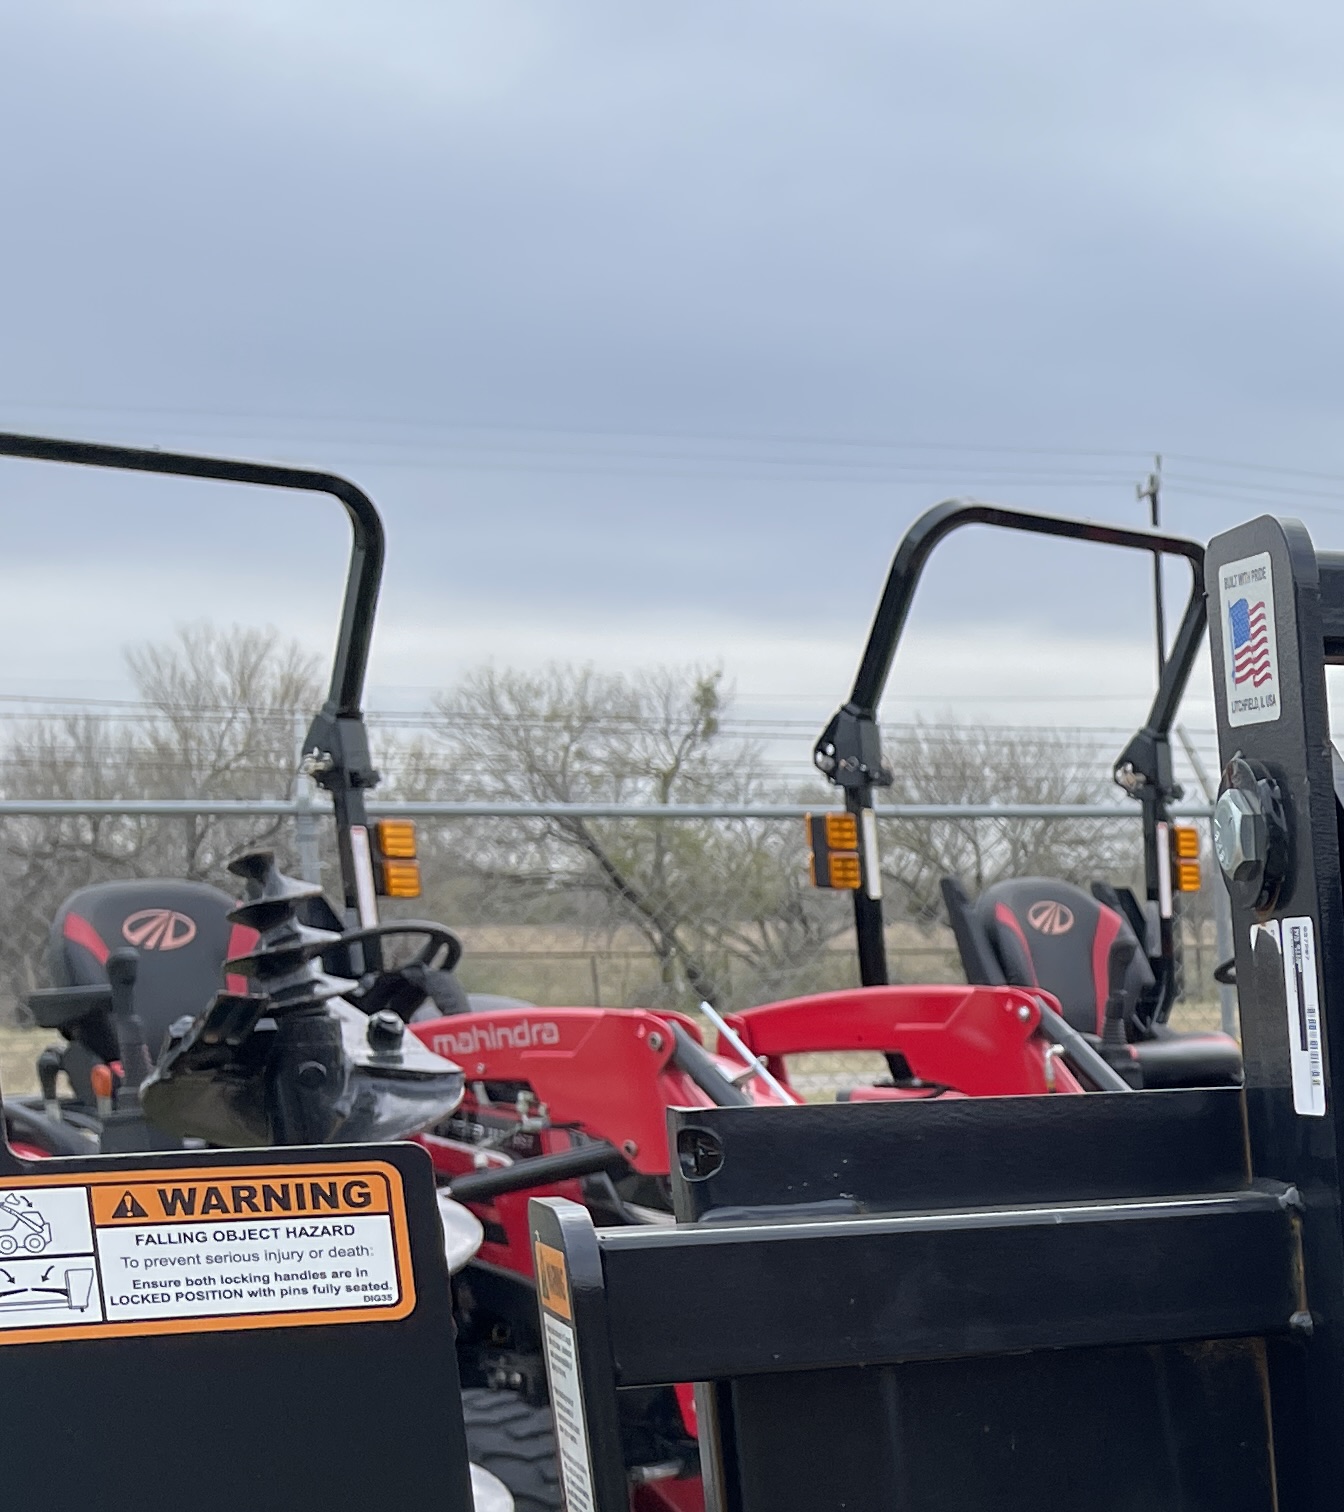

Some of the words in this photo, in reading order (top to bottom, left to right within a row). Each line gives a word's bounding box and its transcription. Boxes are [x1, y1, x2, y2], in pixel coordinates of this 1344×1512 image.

[432, 1019, 560, 1054] mahindra
[157, 1180, 372, 1216] WARNING
[135, 1231, 208, 1246] FALLING
[212, 1227, 281, 1243] OBJECT
[286, 1224, 355, 1239] HAZARD
[120, 1256, 139, 1269] To
[144, 1253, 202, 1270] prevent
[205, 1249, 260, 1265] serious
[264, 1249, 304, 1264] injury
[308, 1248, 323, 1259] or
[328, 1245, 375, 1259] death:
[132, 1279, 181, 1290] Ensure
[185, 1275, 216, 1287] both
[220, 1272, 270, 1285] locking
[274, 1270, 327, 1282] handles
[331, 1269, 352, 1279] are
[355, 1267, 368, 1278] in
[110, 1292, 171, 1306] LOCKED
[175, 1289, 243, 1303] POSITION
[247, 1287, 276, 1299] with
[280, 1286, 309, 1299] pins
[312, 1284, 341, 1296] fully
[345, 1281, 393, 1293] seated.
